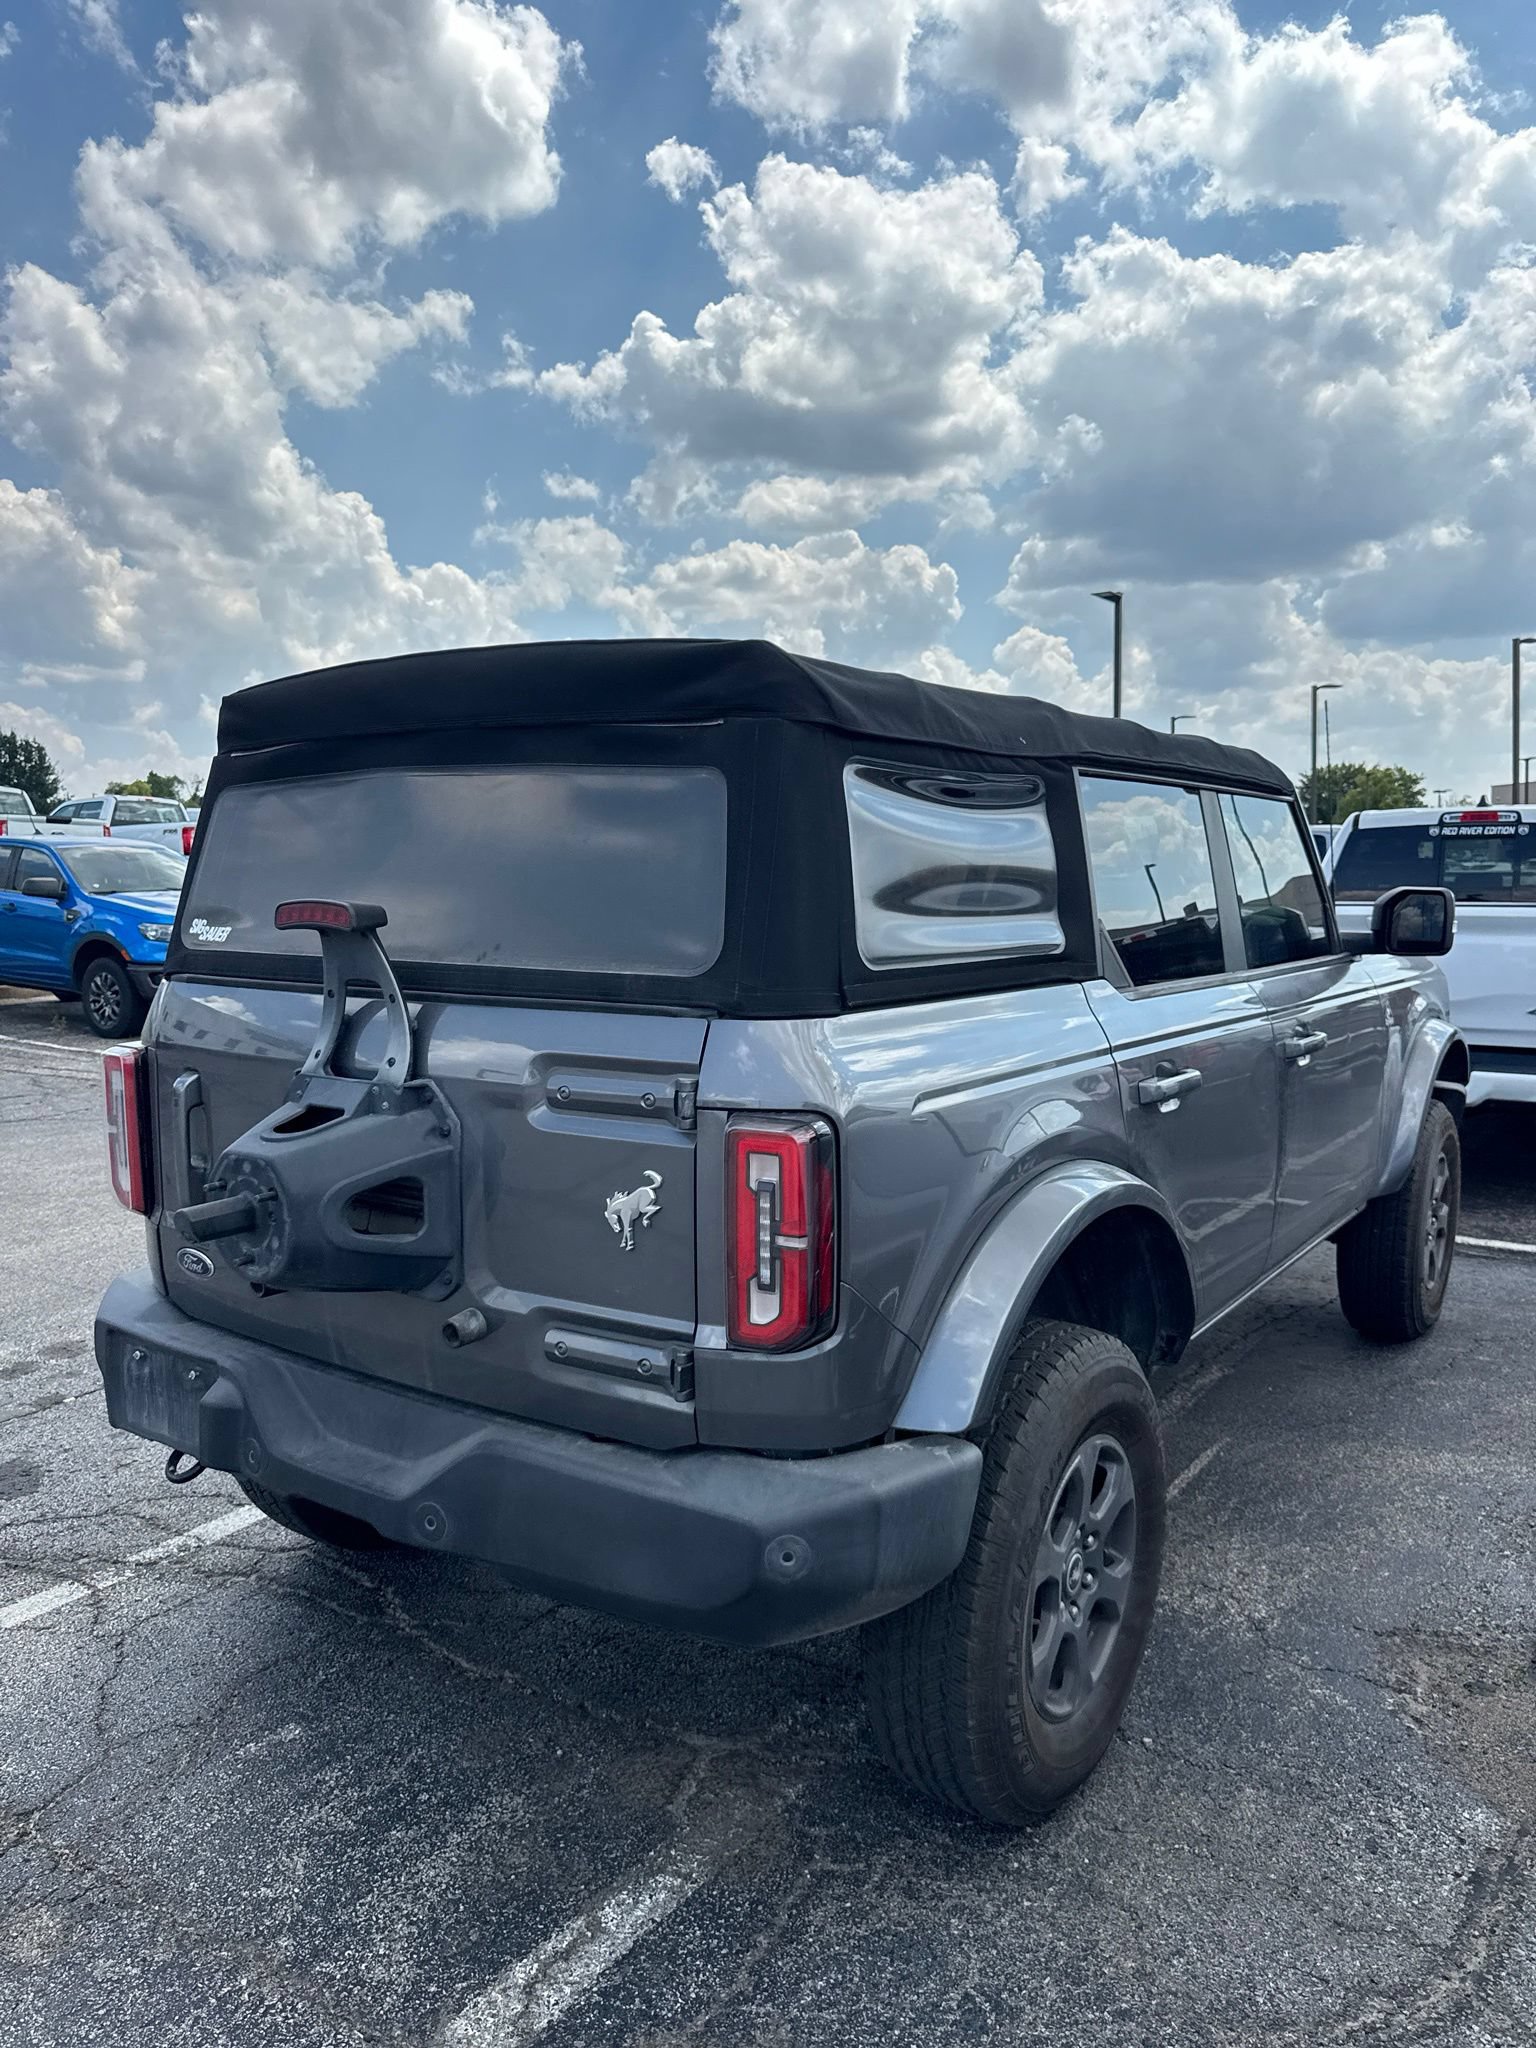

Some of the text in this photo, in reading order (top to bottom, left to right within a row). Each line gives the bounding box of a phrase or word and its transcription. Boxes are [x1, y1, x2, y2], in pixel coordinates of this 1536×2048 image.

[1441, 826, 1516, 835] RED RIVER EDITION
[190, 918, 208, 934] SIG
[198, 926, 232, 942] SAUER
[183, 1253, 204, 1273] Ford
